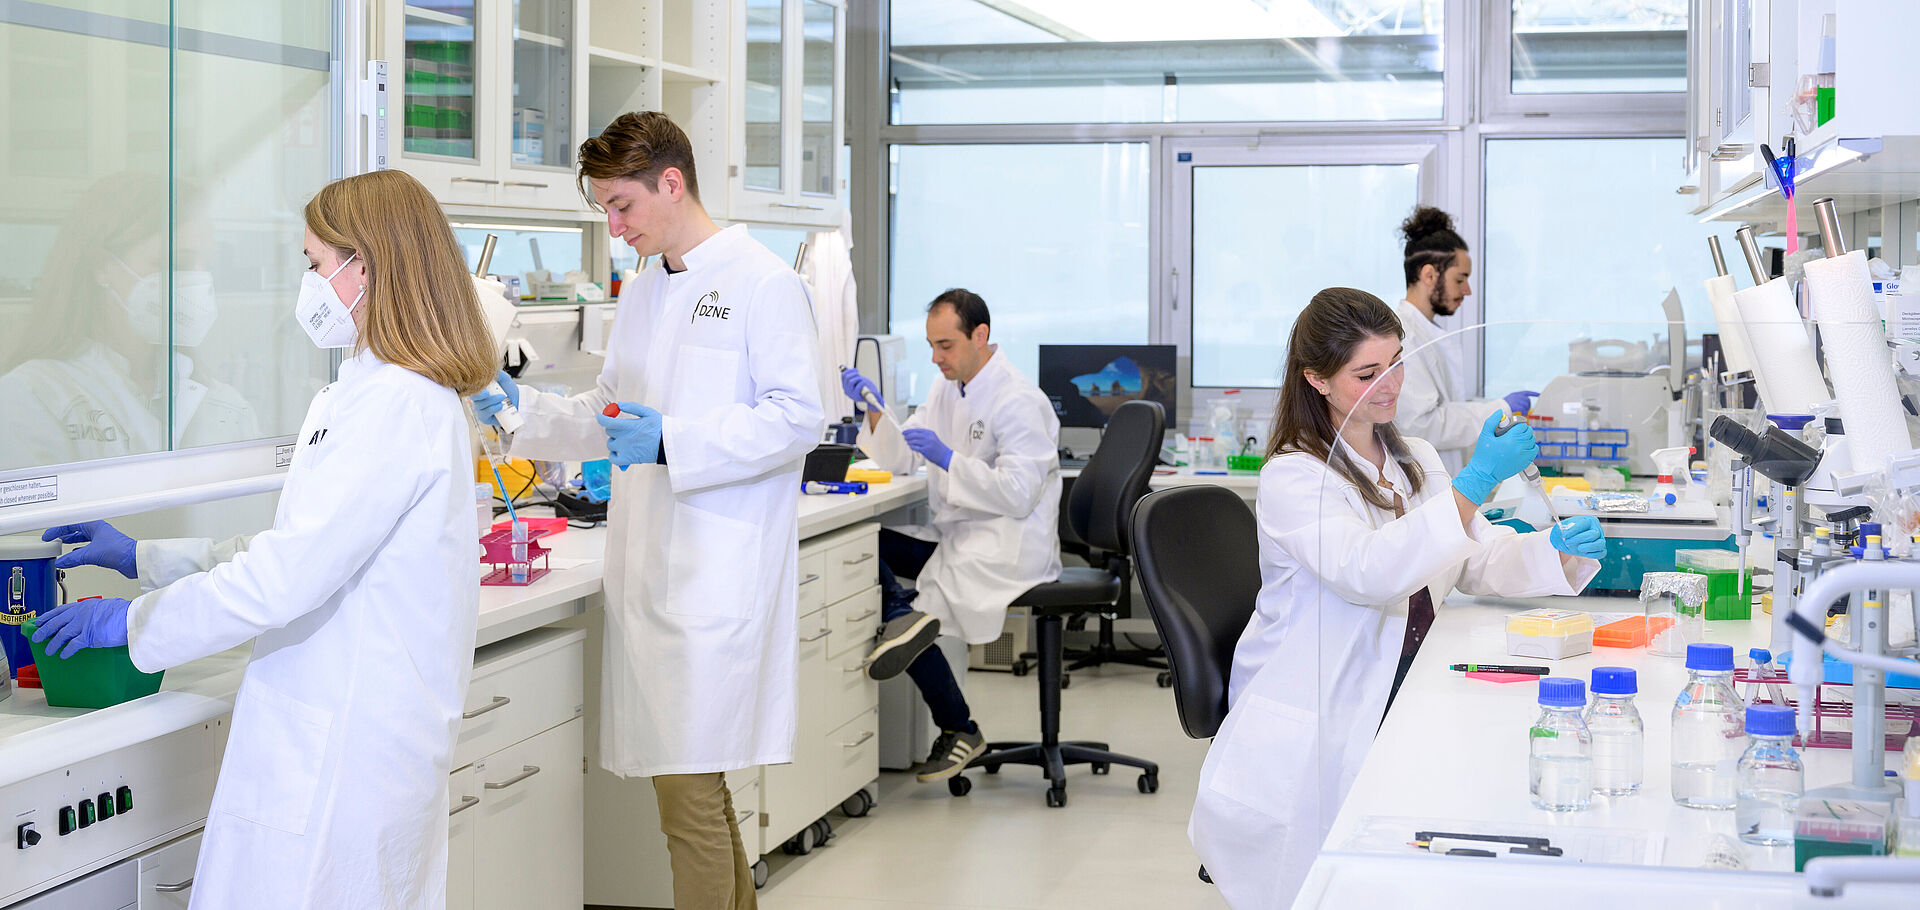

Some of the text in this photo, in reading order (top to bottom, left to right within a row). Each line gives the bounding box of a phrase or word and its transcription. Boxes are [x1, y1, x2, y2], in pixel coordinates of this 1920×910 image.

[699, 305, 730, 320] DZNE
[4, 496, 17, 504] closed
[18, 493, 37, 502] whenever
